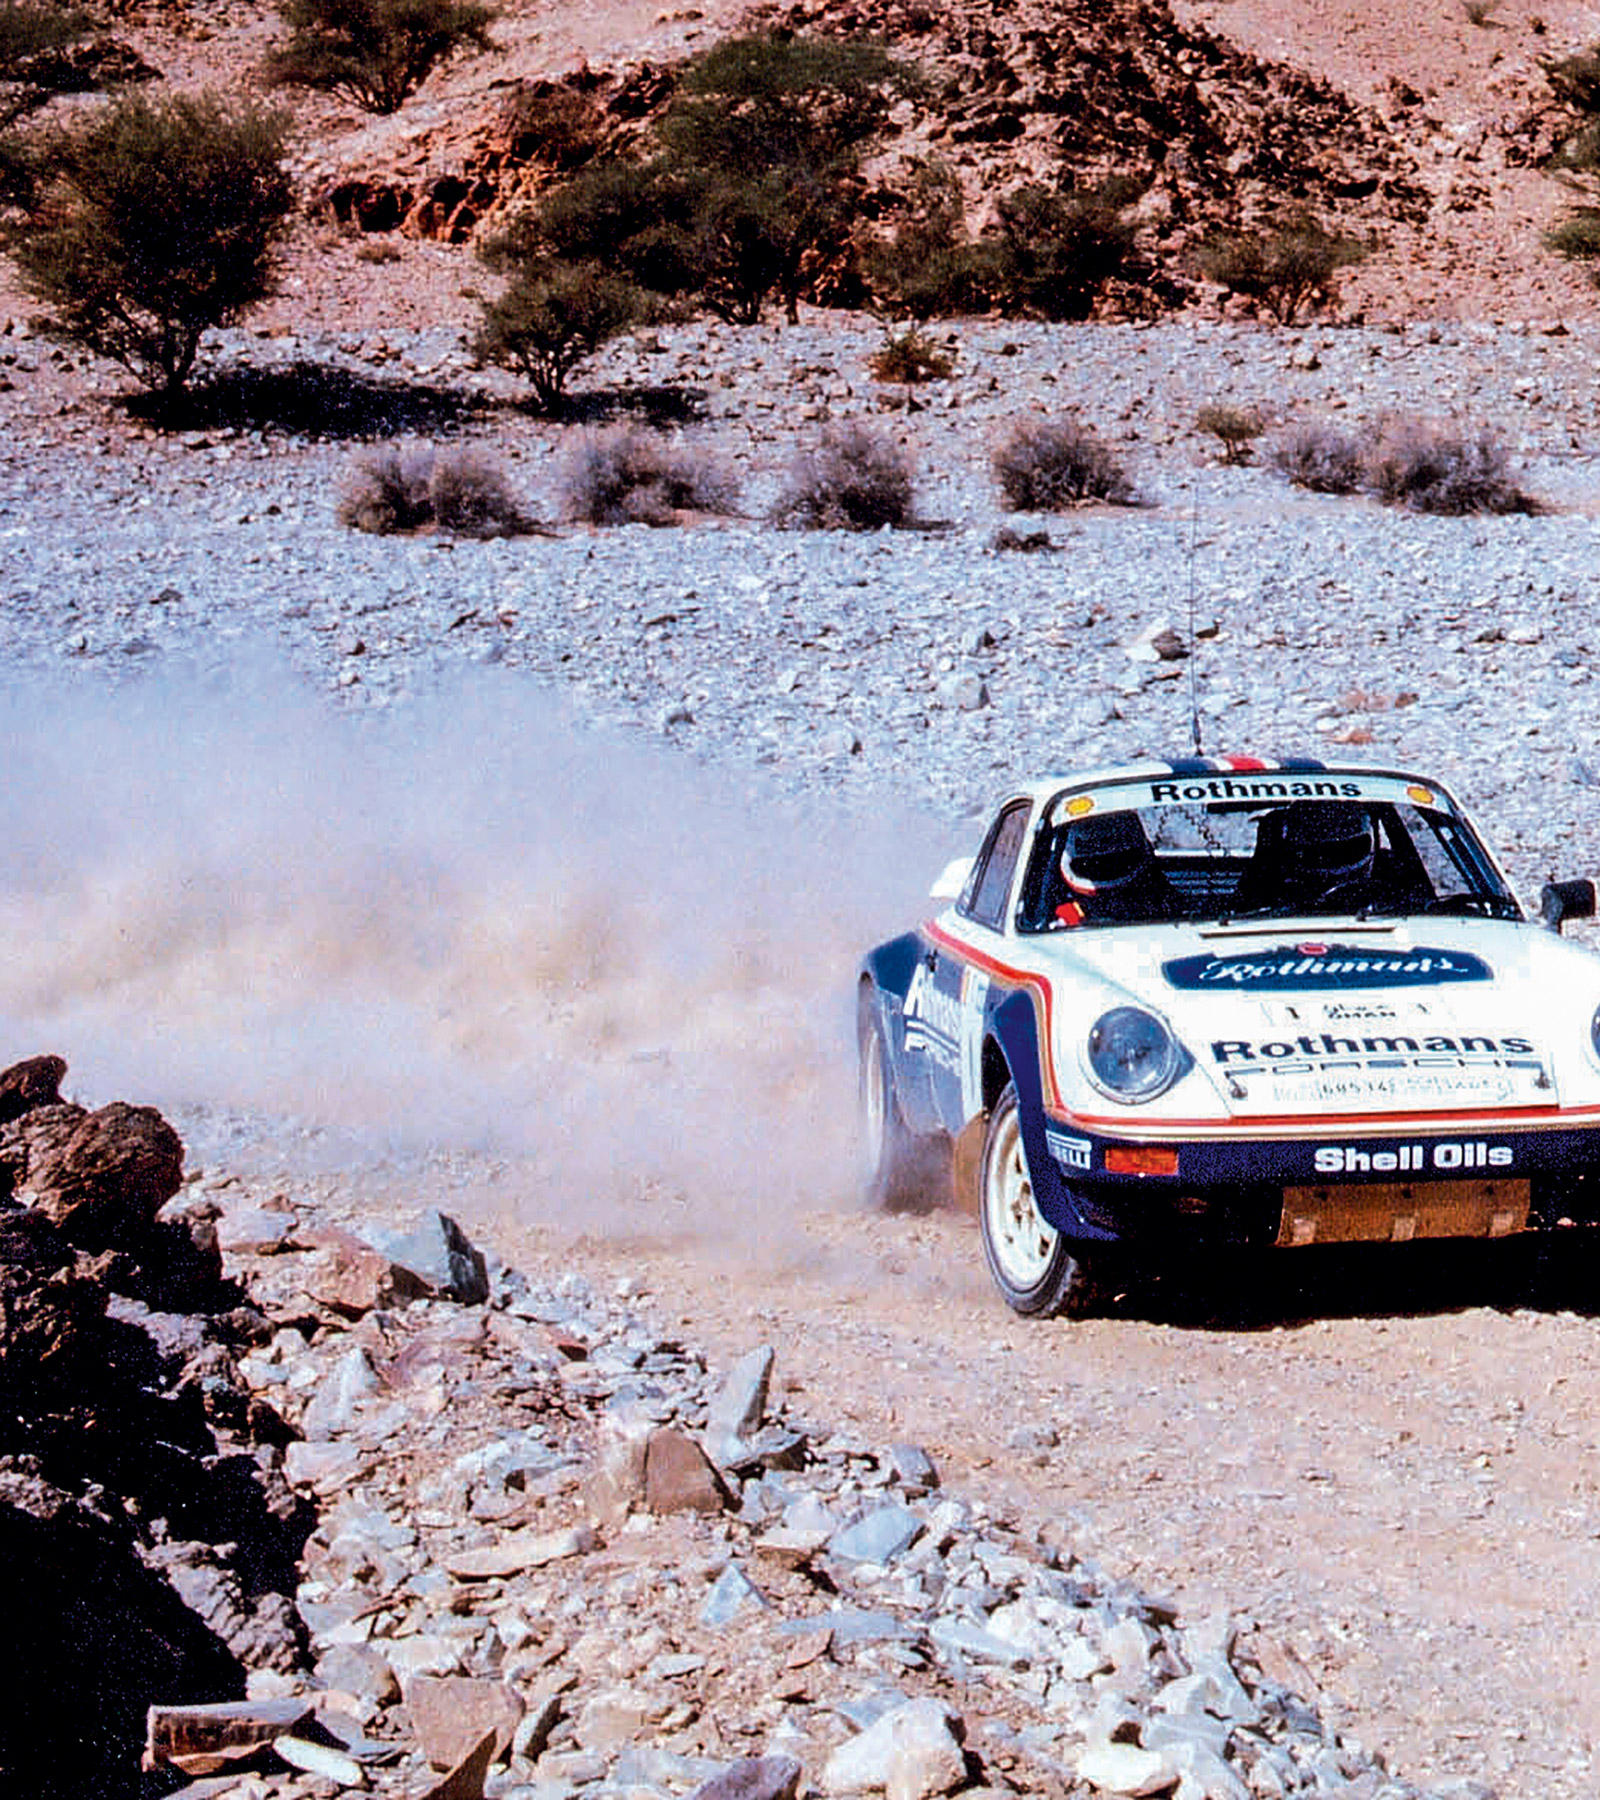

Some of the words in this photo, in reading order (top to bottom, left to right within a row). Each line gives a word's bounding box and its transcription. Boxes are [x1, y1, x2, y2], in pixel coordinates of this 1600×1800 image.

[1151, 780, 1362, 802] Rothmans
[1199, 957, 1468, 982] Rothmans
[1211, 1034, 1535, 1064] Rothmans
[1314, 1145, 1423, 1172] Shell
[1433, 1142, 1513, 1168] Oils
